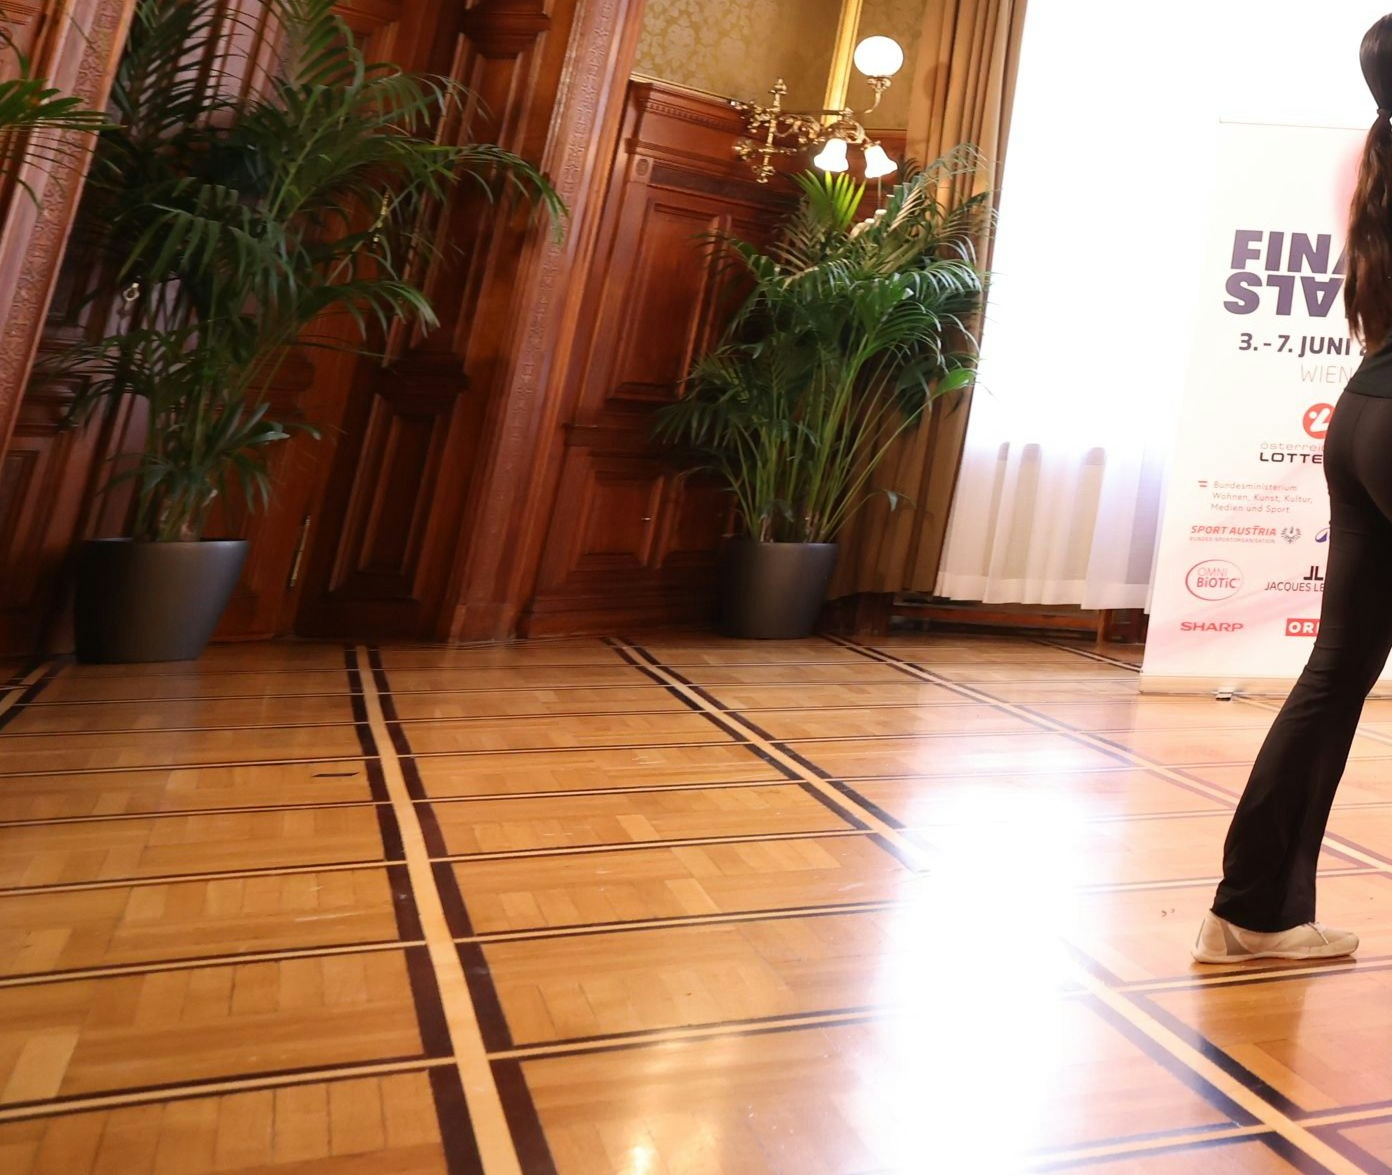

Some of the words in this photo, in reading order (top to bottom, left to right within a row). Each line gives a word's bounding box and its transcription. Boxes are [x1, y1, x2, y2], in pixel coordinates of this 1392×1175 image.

[1230, 229, 1348, 275] FIN
[1223, 271, 1345, 318] ALS
[1297, 335, 1351, 358] JUNI
[1259, 452, 1323, 464] LOTTE
[1246, 504, 1263, 512] und
[1266, 505, 1291, 514] Sport
[1191, 526, 1228, 535] SPORT
[1229, 525, 1277, 537] AUSTRIA
[1264, 581, 1311, 592] JACQUES
[1313, 582, 1325, 593] LE
[1180, 621, 1244, 632] SHARP
